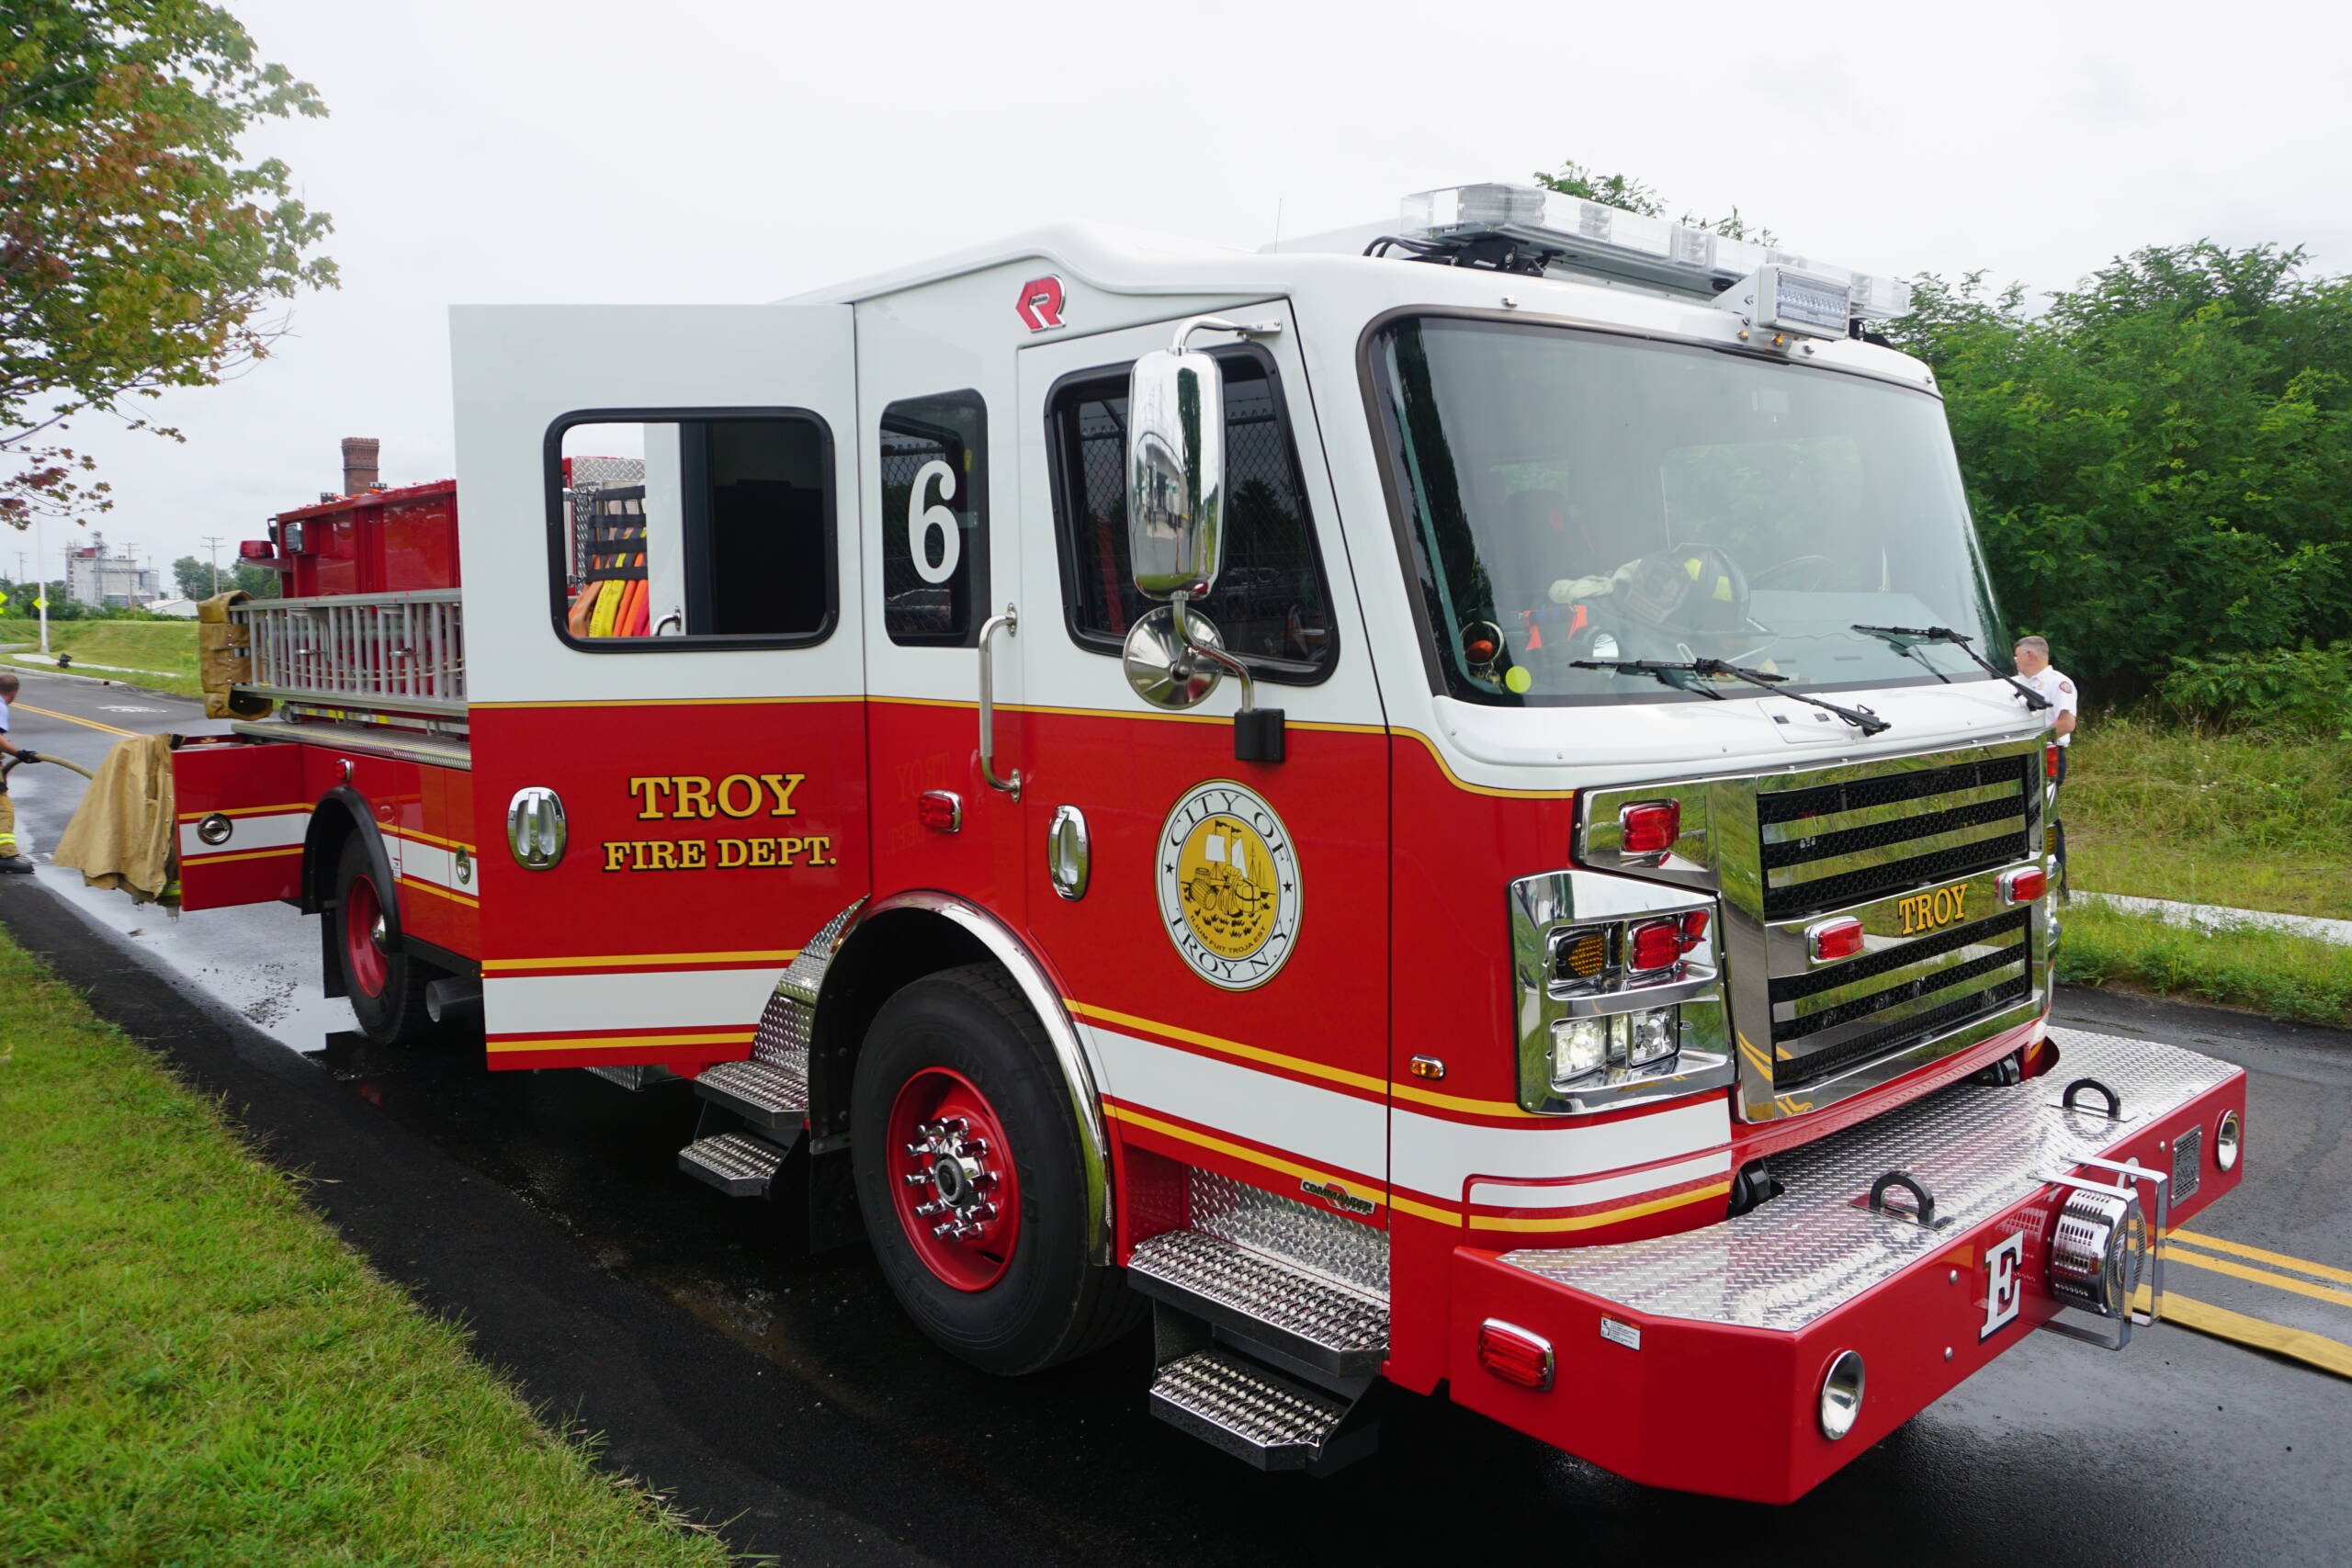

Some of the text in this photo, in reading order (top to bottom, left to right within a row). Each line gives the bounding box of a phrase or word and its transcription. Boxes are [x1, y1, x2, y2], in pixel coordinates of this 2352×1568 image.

[909, 460, 960, 584] 6
[630, 773, 805, 819] TROY
[603, 836, 837, 872] FIRE DEPT.
[1170, 792, 1289, 862] CITY OF
[1898, 884, 1968, 936] TROY
[1172, 908, 1238, 978] TROY
[1302, 1181, 1374, 1213] COMMANDER
[1980, 1230, 2024, 1343] E
